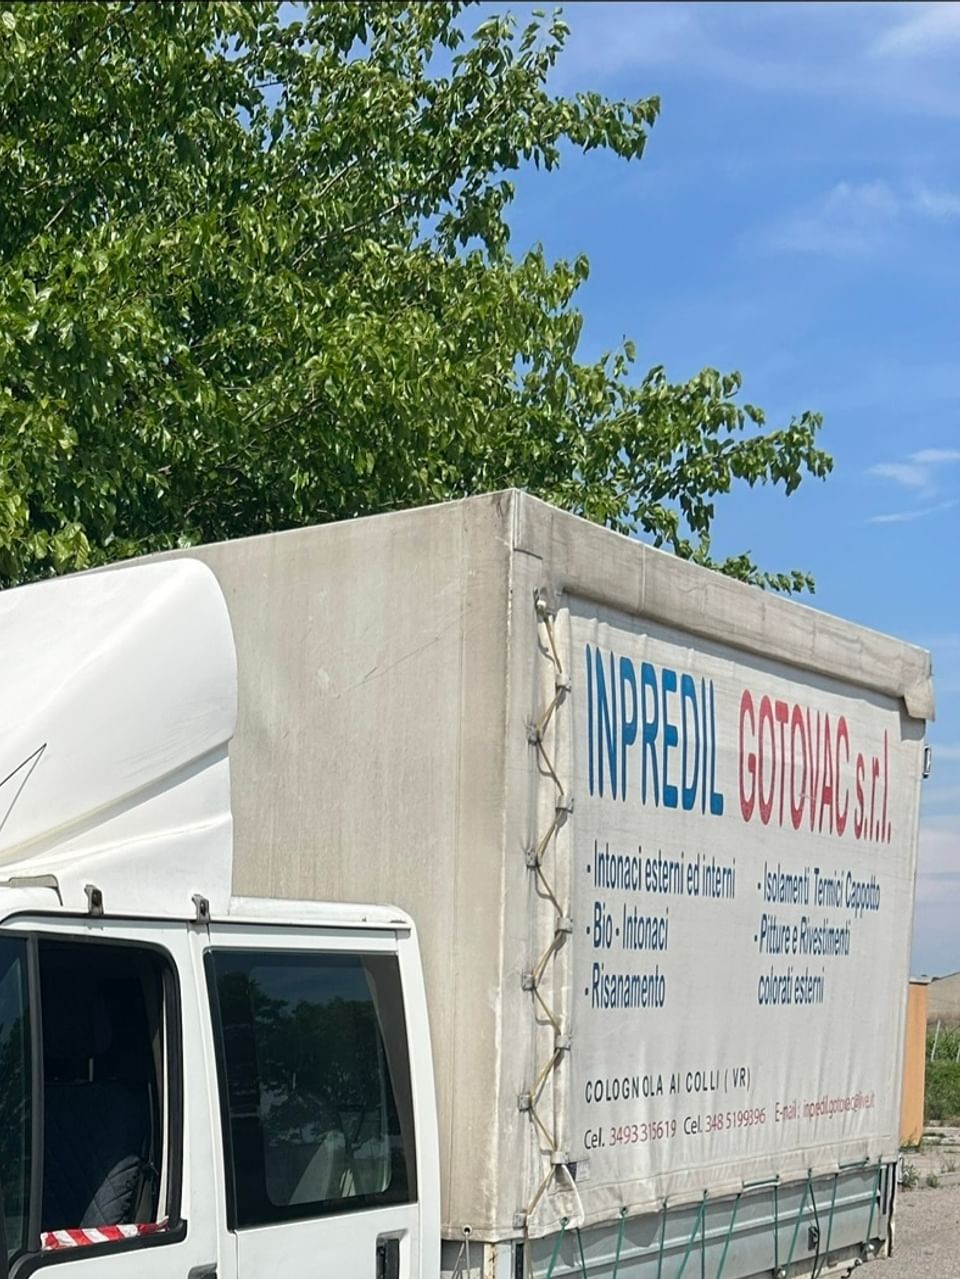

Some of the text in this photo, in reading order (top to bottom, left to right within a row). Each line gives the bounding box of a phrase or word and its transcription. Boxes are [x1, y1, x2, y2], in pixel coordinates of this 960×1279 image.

[586, 643, 891, 843] INPREDIL GOTOVAC s.r.l.
[595, 840, 735, 899] Intonaci esterni ed interni
[814, 867, 844, 907] Termici
[845, 871, 881, 918] Cappotto
[593, 901, 613, 949] Bio
[622, 903, 669, 950] Intonaci
[792, 925, 798, 955] e
[800, 916, 851, 956] Rivestimenti
[592, 962, 666, 1009] Risanamento
[758, 964, 825, 1005] colorati esterni
[585, 1074, 663, 1103] COLOGNOLA
[669, 1072, 680, 1095] AI
[685, 1070, 720, 1093] COLLI
[584, 1127, 605, 1149] Cel.
[683, 1115, 703, 1135] Cel.
